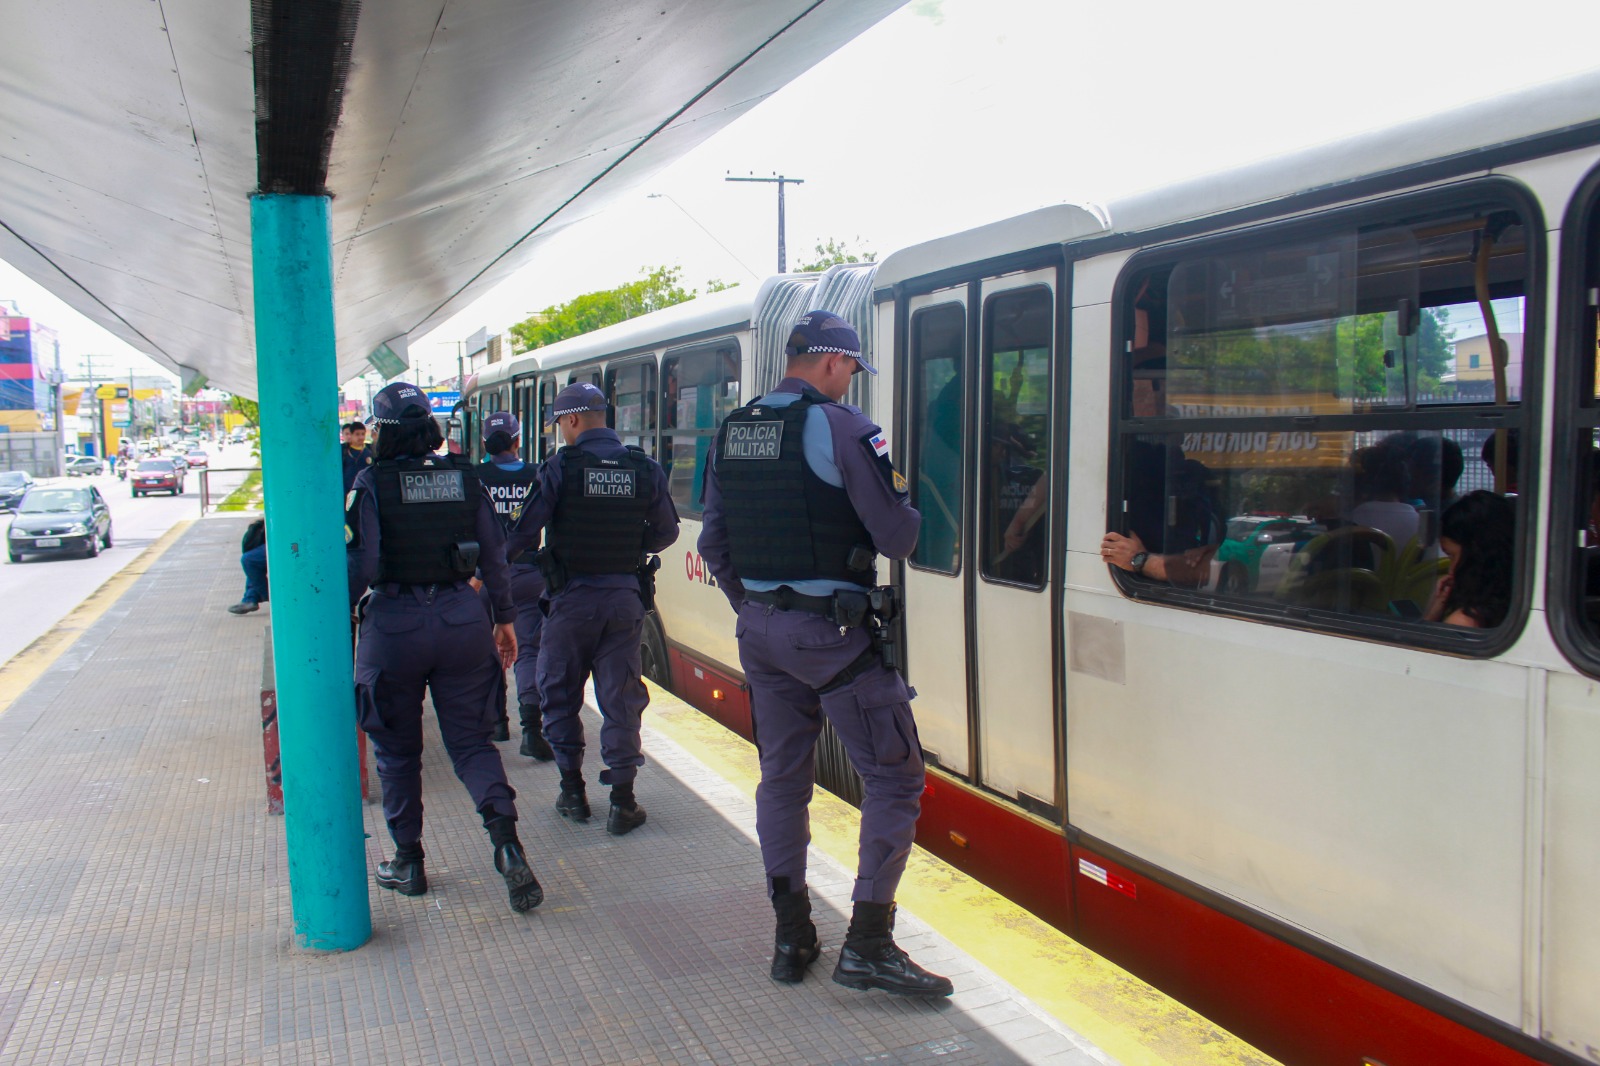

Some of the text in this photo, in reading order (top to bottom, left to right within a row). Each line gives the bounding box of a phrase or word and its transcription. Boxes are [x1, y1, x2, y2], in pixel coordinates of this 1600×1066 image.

[730, 424, 776, 440] POLÍCIA
[728, 442, 775, 456] MILITAR
[405, 472, 458, 487] POLÍCIA
[588, 471, 632, 484] POLÍCIA
[407, 488, 459, 500] MILITAR
[490, 484, 527, 499] POLÍCI
[588, 484, 632, 495] MILITAR
